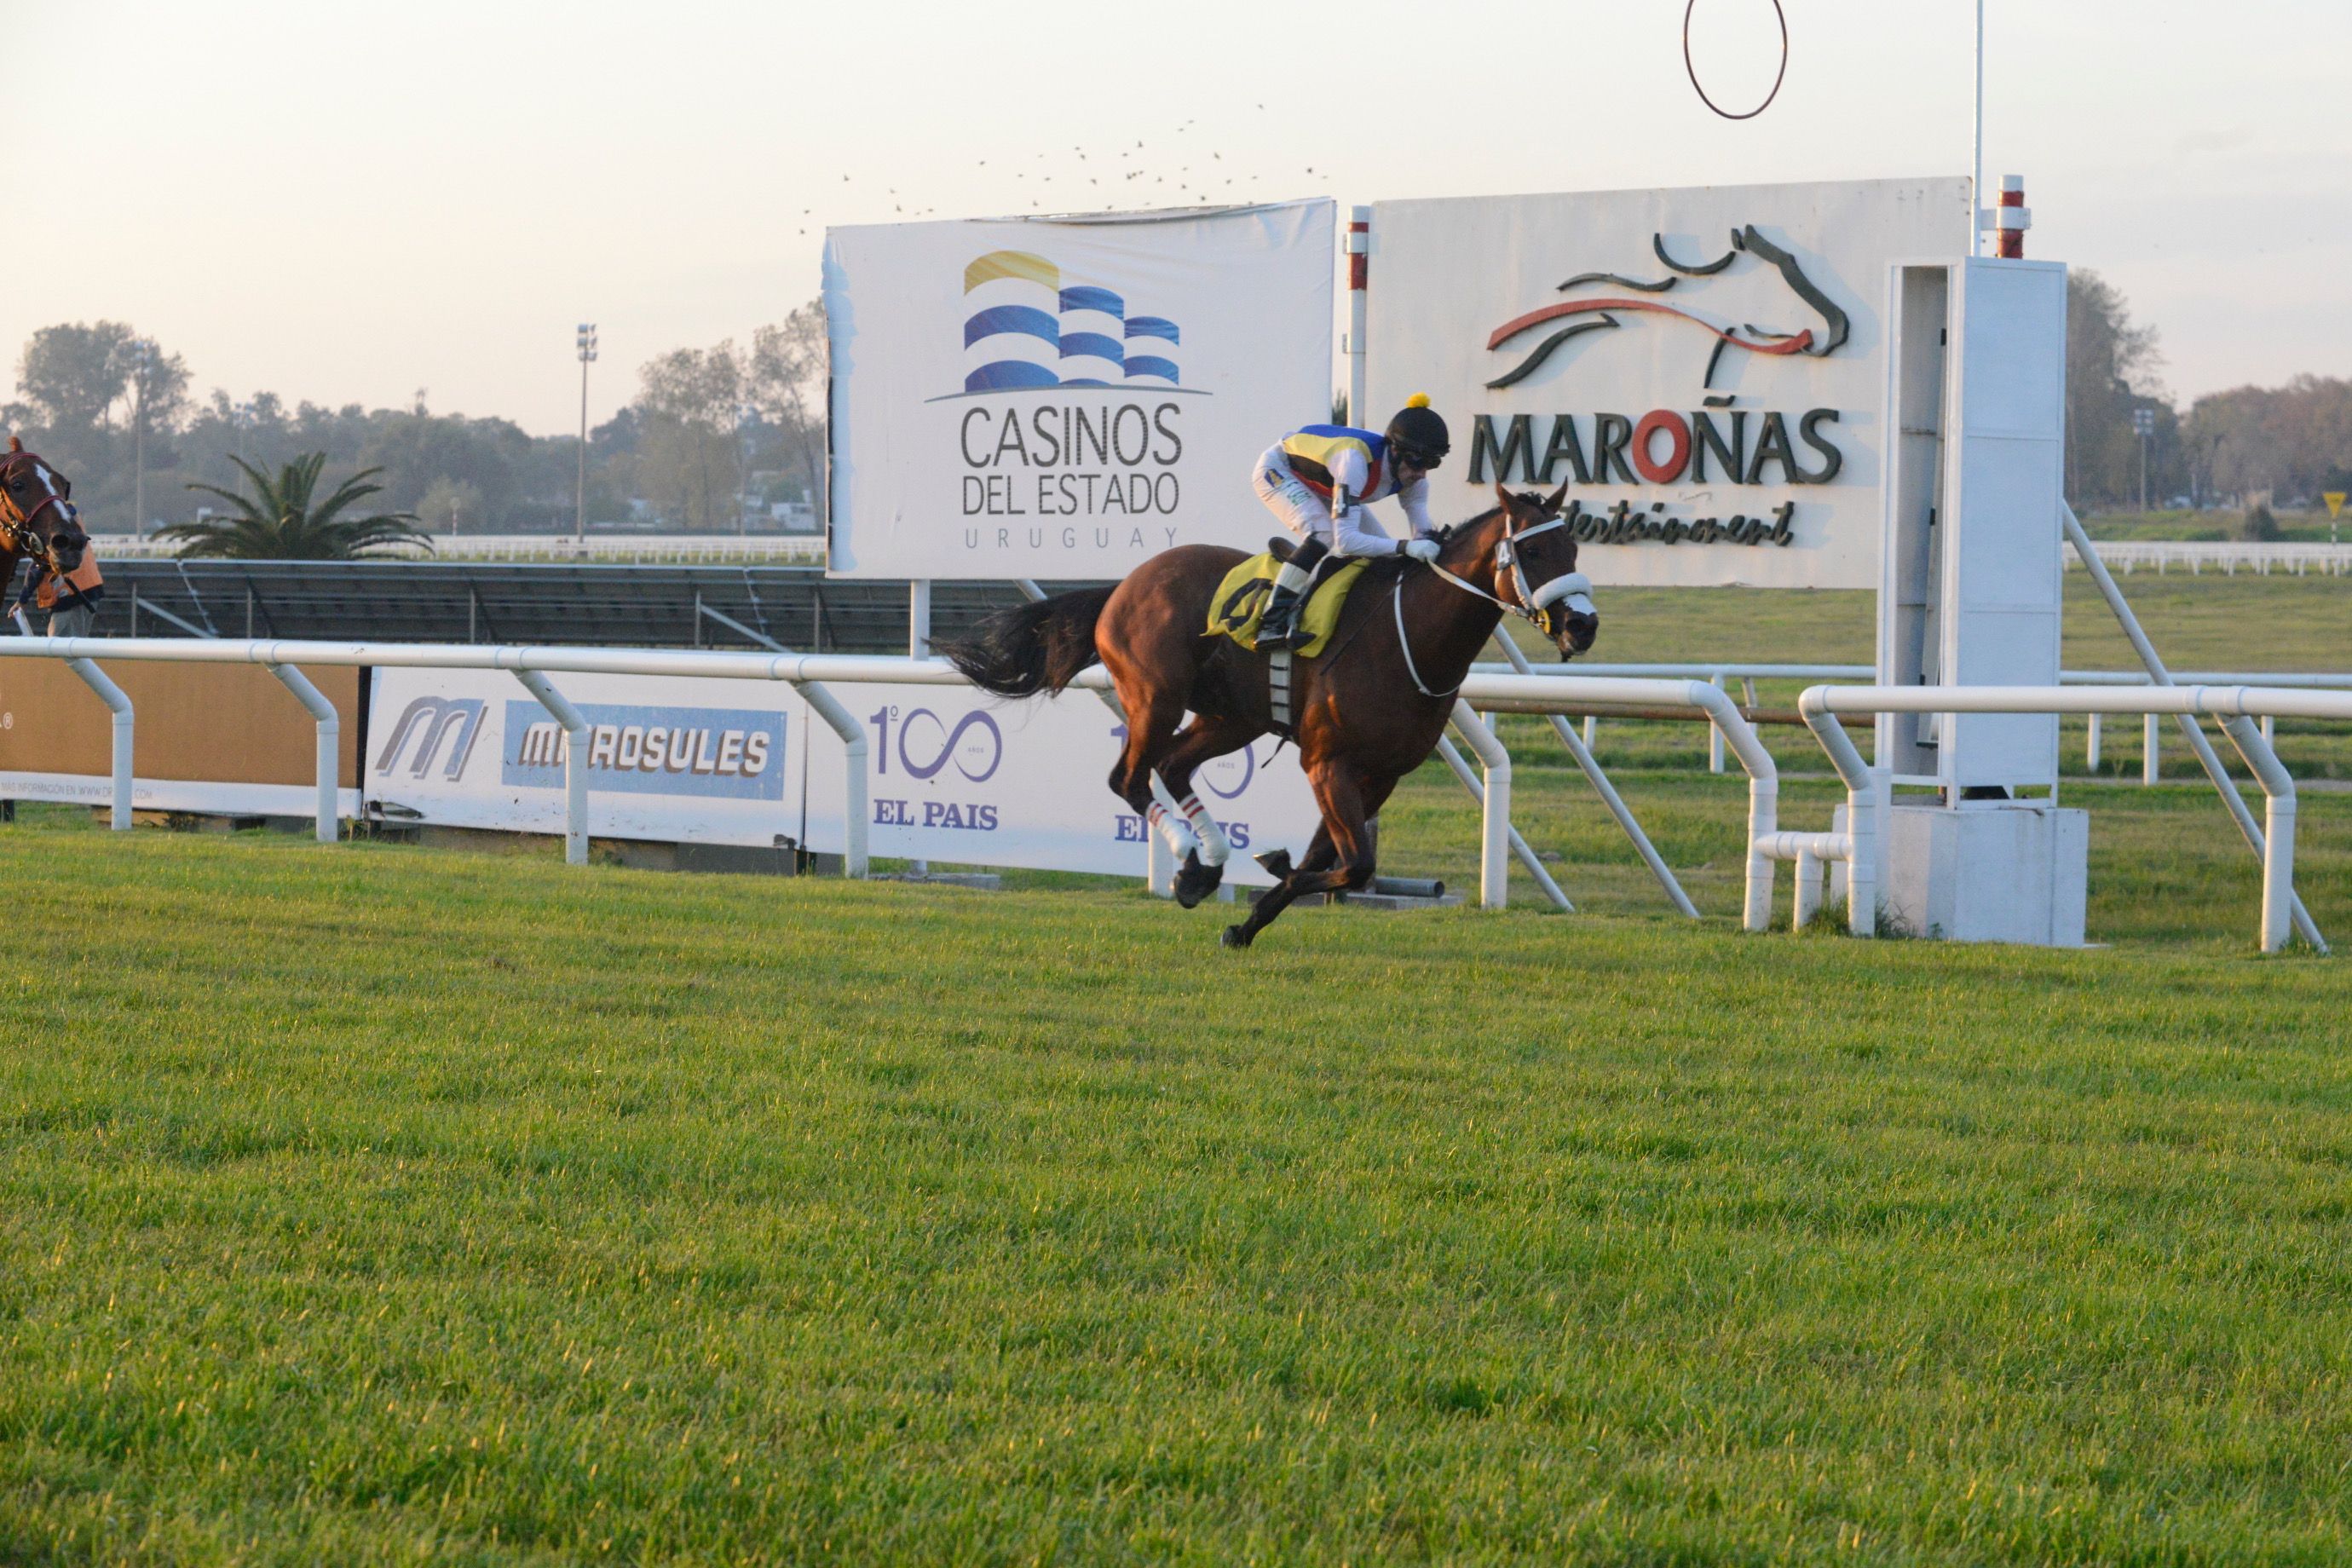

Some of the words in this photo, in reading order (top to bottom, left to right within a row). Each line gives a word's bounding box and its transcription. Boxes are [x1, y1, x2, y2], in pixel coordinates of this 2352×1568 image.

[960, 402, 1182, 468] CASINOS
[1467, 395, 1842, 485] MAROÑAS
[962, 475, 1025, 515] DEL
[1038, 472, 1179, 515] ESTADO
[966, 527, 1177, 549] URUGUAY
[1559, 499, 1796, 546] tertainment
[1498, 540, 1511, 563] 4
[517, 722, 770, 777] MIROSULES
[873, 798, 914, 827] EL
[923, 801, 998, 831] PAIS
